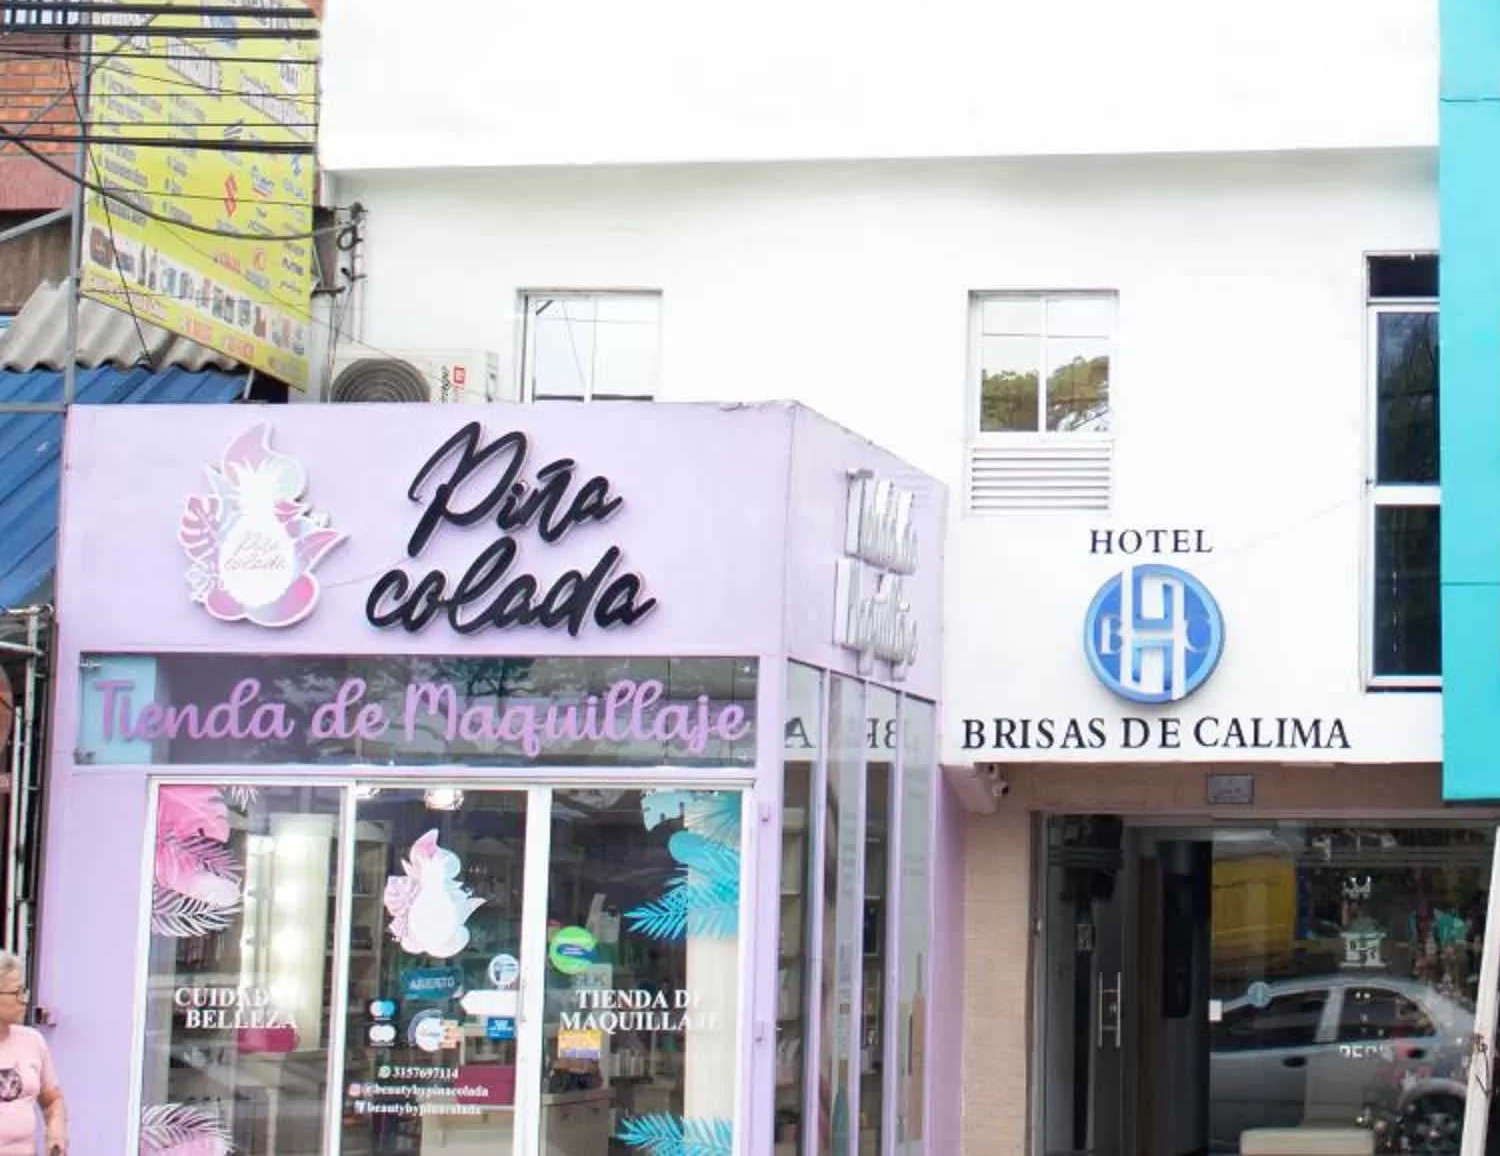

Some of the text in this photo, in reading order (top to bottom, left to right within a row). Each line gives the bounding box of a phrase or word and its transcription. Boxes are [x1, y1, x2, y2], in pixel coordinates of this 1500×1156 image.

[407, 421, 624, 558] Piña
[1089, 529, 1213, 555] HOTEL
[365, 535, 657, 638] colada
[94, 678, 295, 744] Tienda
[311, 680, 388, 741] de
[404, 680, 750, 759] Maquillaje
[962, 717, 1352, 750] BRISAS DE CALIMA
[576, 989, 669, 1009] TIENDA
[184, 1009, 298, 1029] BELLEZA
